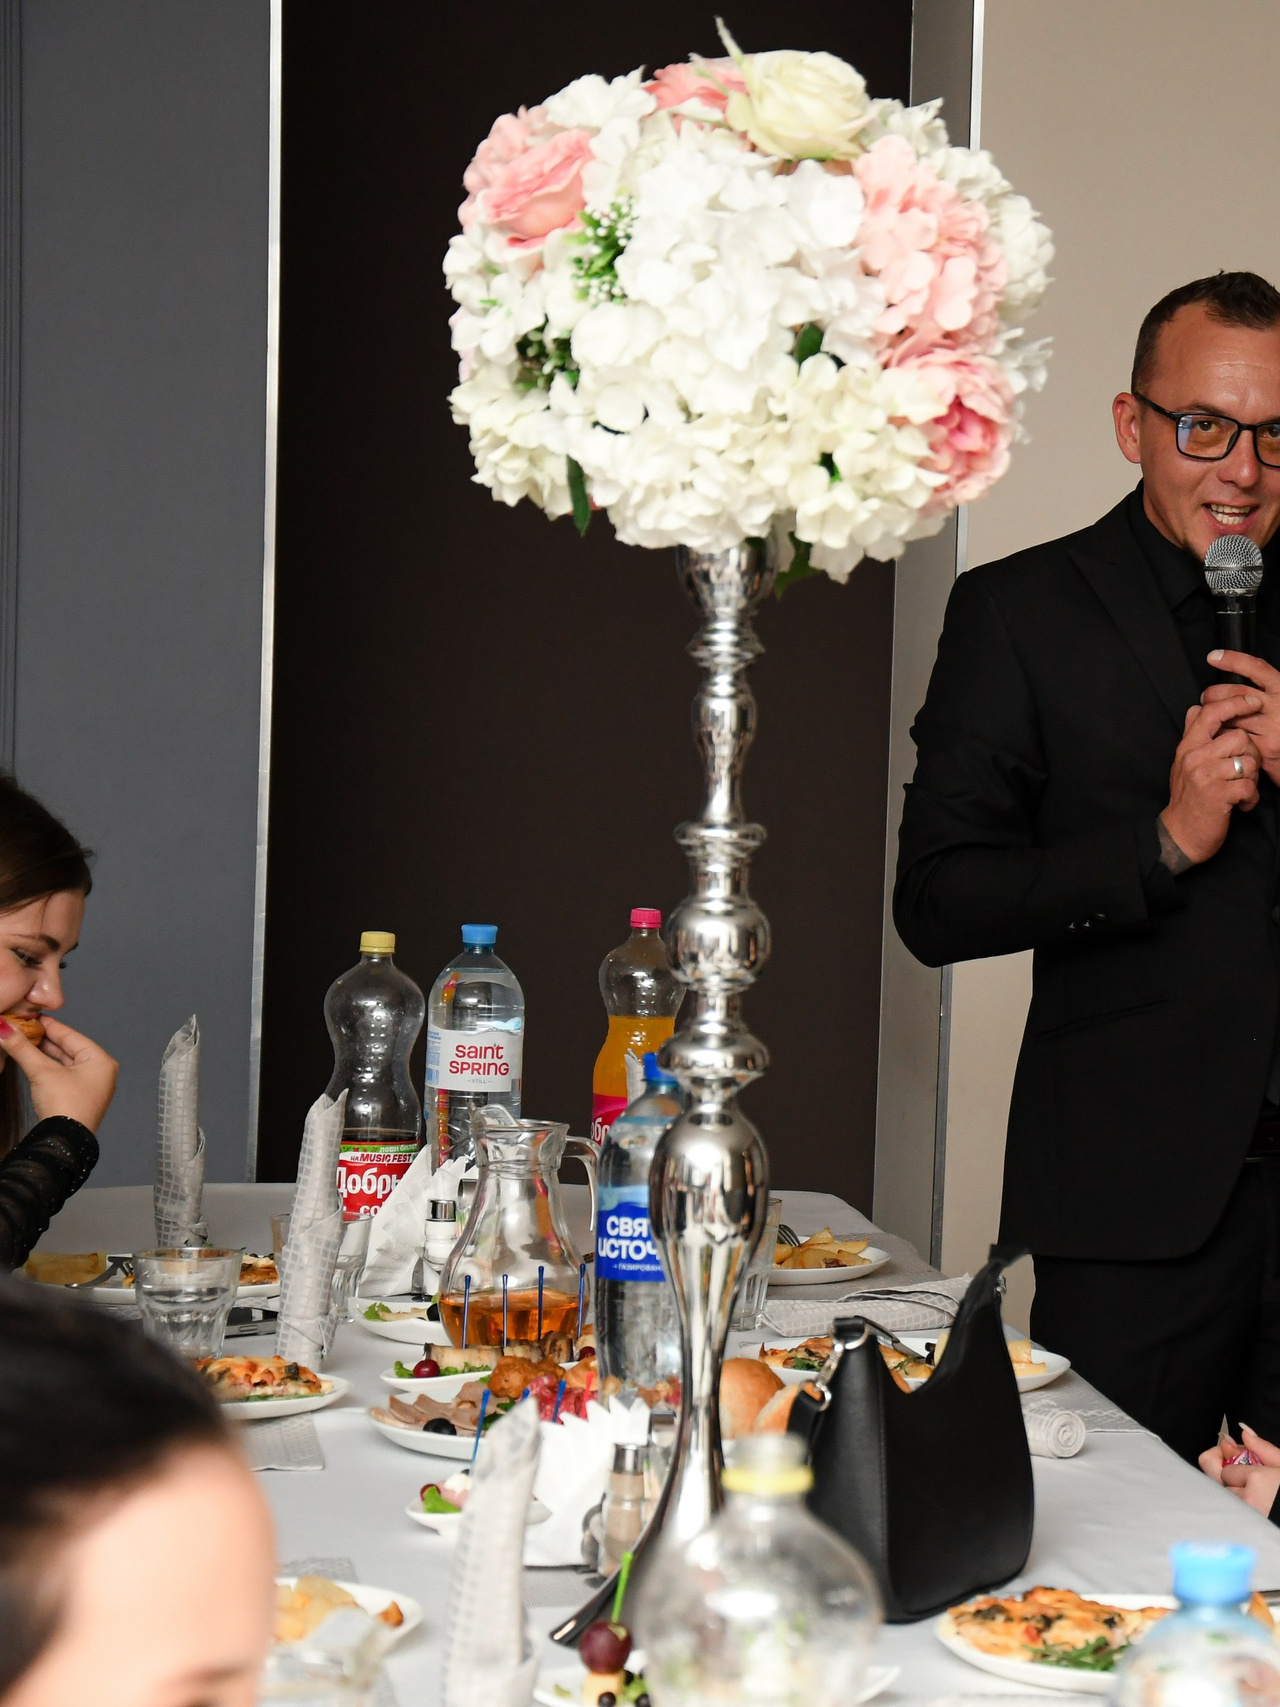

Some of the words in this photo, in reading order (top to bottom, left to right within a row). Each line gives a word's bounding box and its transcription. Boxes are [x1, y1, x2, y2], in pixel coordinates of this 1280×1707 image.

[590, 1117, 611, 1146] обр
[359, 1153, 391, 1163] MUSIC
[392, 1153, 412, 1163] FEST
[337, 1167, 401, 1199] Добр
[606, 1215, 651, 1238] СВЯ
[598, 1237, 660, 1261] ИСТОЧ
[618, 1263, 661, 1272] ГАЗИРОВАН
